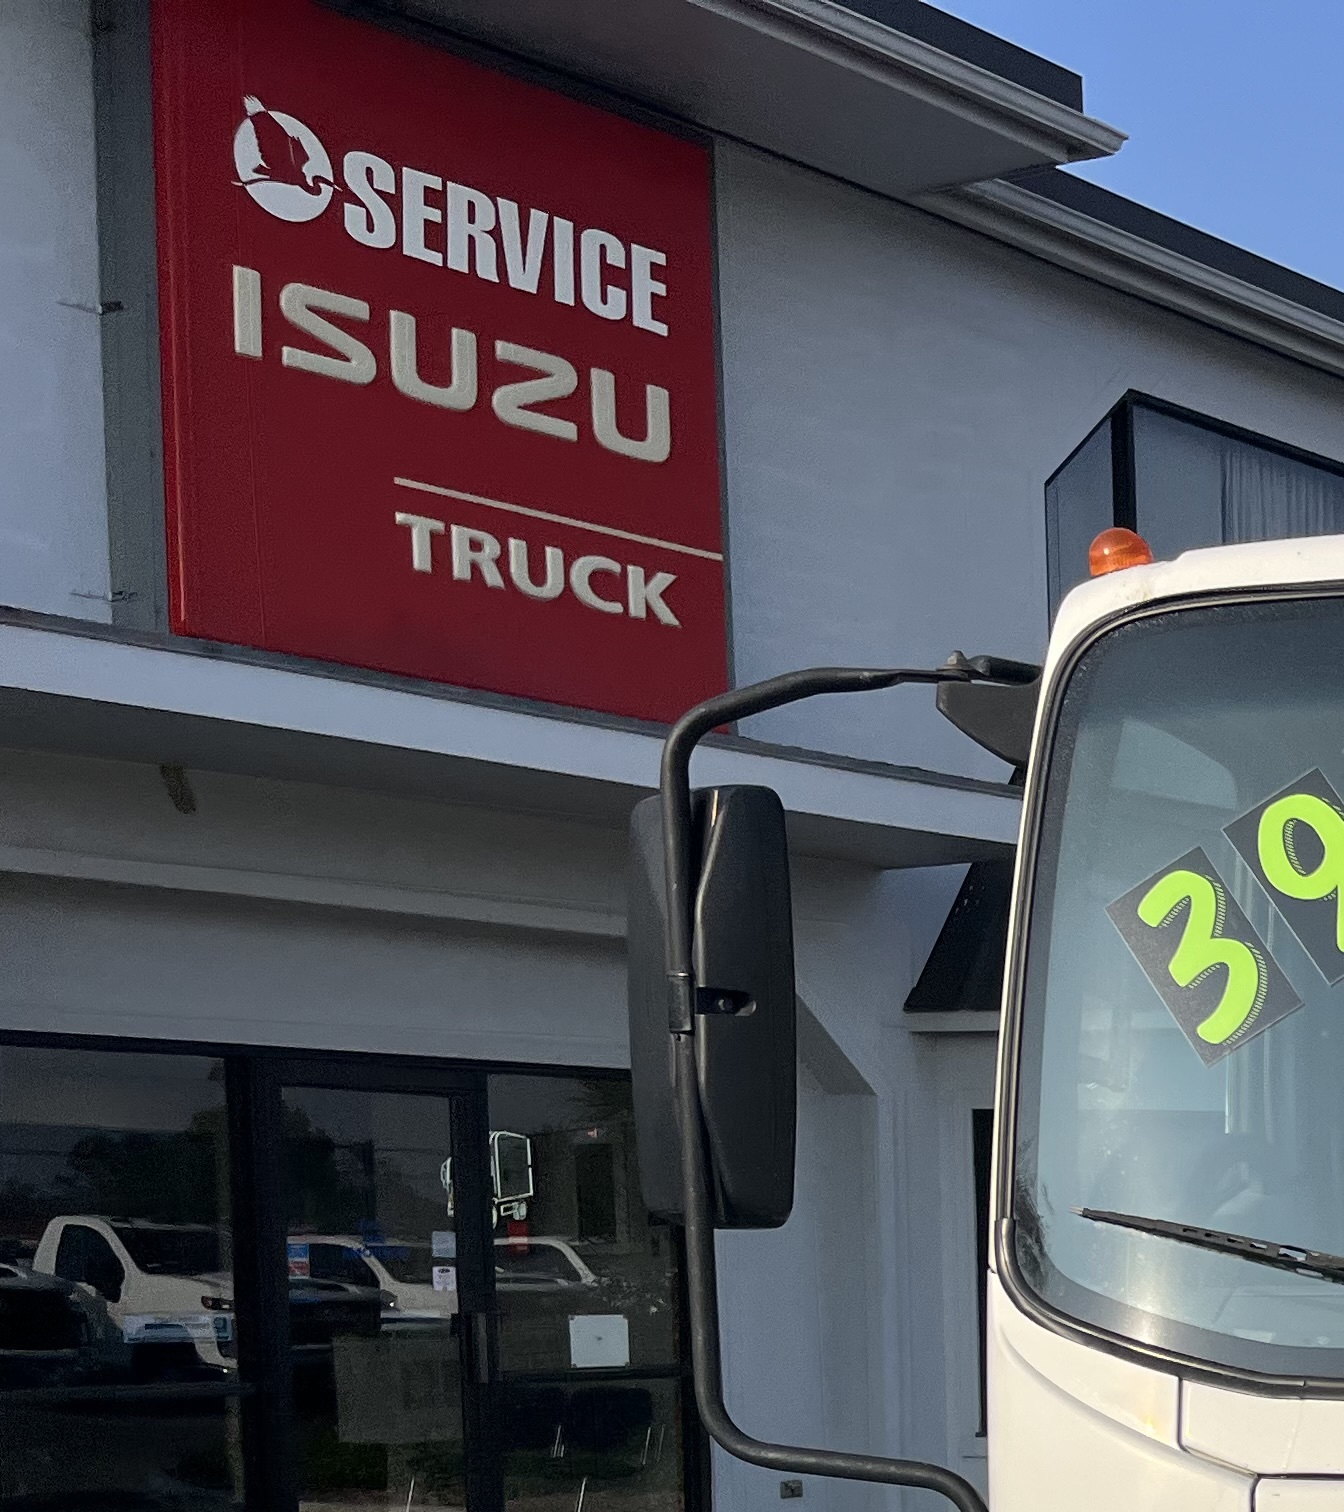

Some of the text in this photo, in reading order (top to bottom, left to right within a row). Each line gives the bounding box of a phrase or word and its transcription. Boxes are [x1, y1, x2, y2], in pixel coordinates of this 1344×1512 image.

[343, 150, 669, 337] SERVICE
[232, 264, 672, 464] ISUZU
[394, 511, 682, 627] TRUCK
